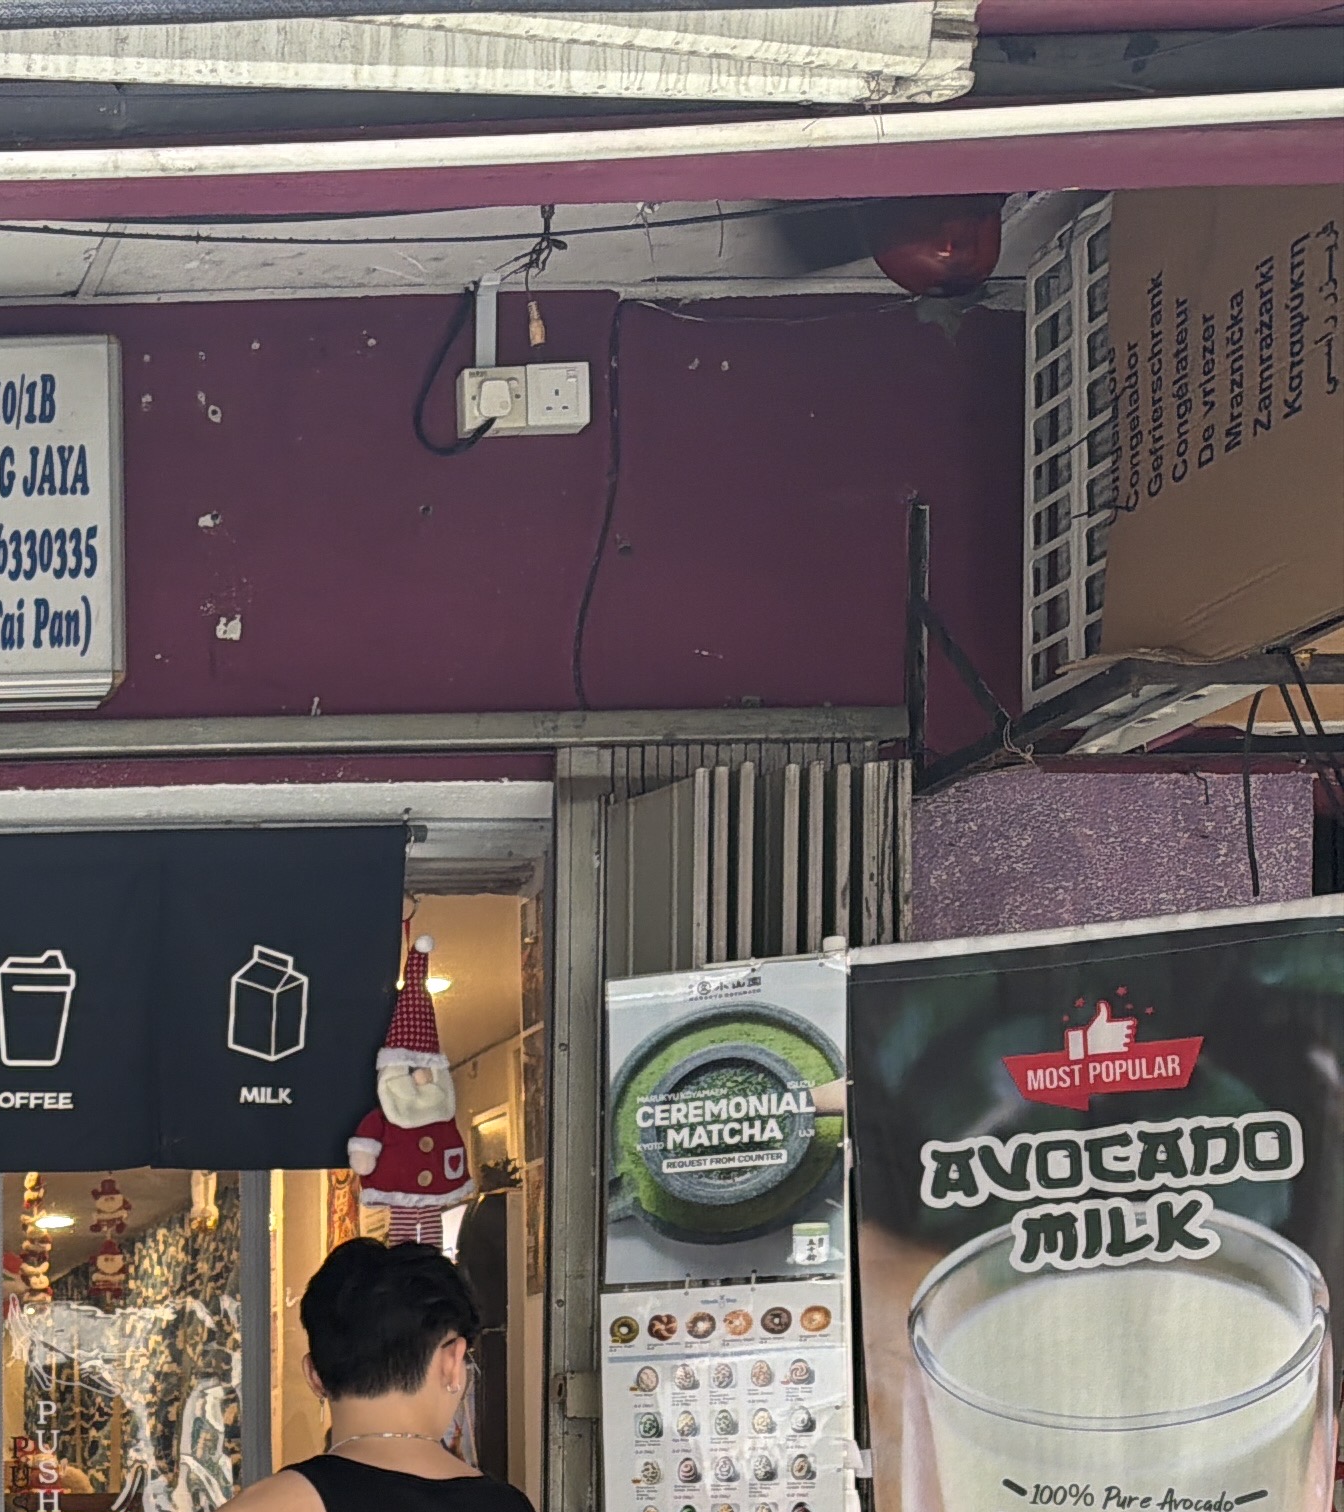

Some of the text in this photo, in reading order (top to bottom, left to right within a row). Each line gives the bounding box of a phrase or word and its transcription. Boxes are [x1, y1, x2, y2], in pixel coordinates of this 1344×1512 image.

[1225, 289, 1244, 453] Mraznička
[1254, 255, 1274, 437] Zamrażarki
[1148, 270, 1163, 497] Gefrierschrank
[1172, 298, 1192, 482] Congélateur
[22, 443, 90, 499] JAYA
[1199, 424, 1215, 469] De
[33, 596, 93, 659] Pan)
[239, 1085, 293, 1106] MILK
[1027, 1055, 1181, 1091] MOST POPULAR
[636, 1091, 817, 1128] CEREMONIAL
[666, 1117, 784, 1150] MATCHA
[666, 1152, 784, 1170] REQUEST FROM COUNTER
[925, 1115, 1298, 1203] AVOCADO
[1015, 1196, 1215, 1268] MILK
[36, 1400, 62, 1512] PUSH
[1029, 1483, 1235, 1512] 100% Pure Avocado
